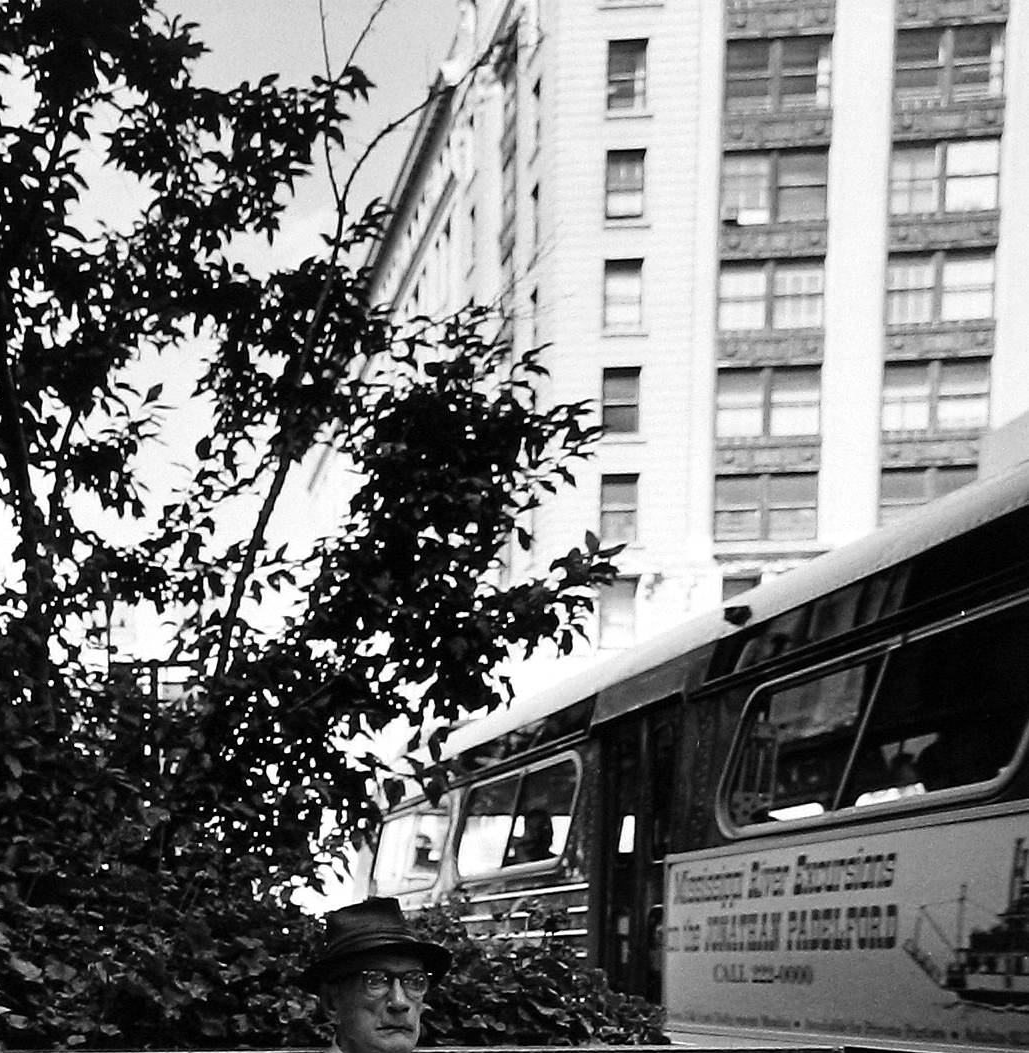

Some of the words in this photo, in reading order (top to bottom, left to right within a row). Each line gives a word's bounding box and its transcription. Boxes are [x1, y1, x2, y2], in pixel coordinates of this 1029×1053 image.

[747, 860, 790, 898] River
[793, 847, 898, 895] Excursions
[786, 904, 898, 951] PADELFORD
[712, 963, 748, 984] CALL
